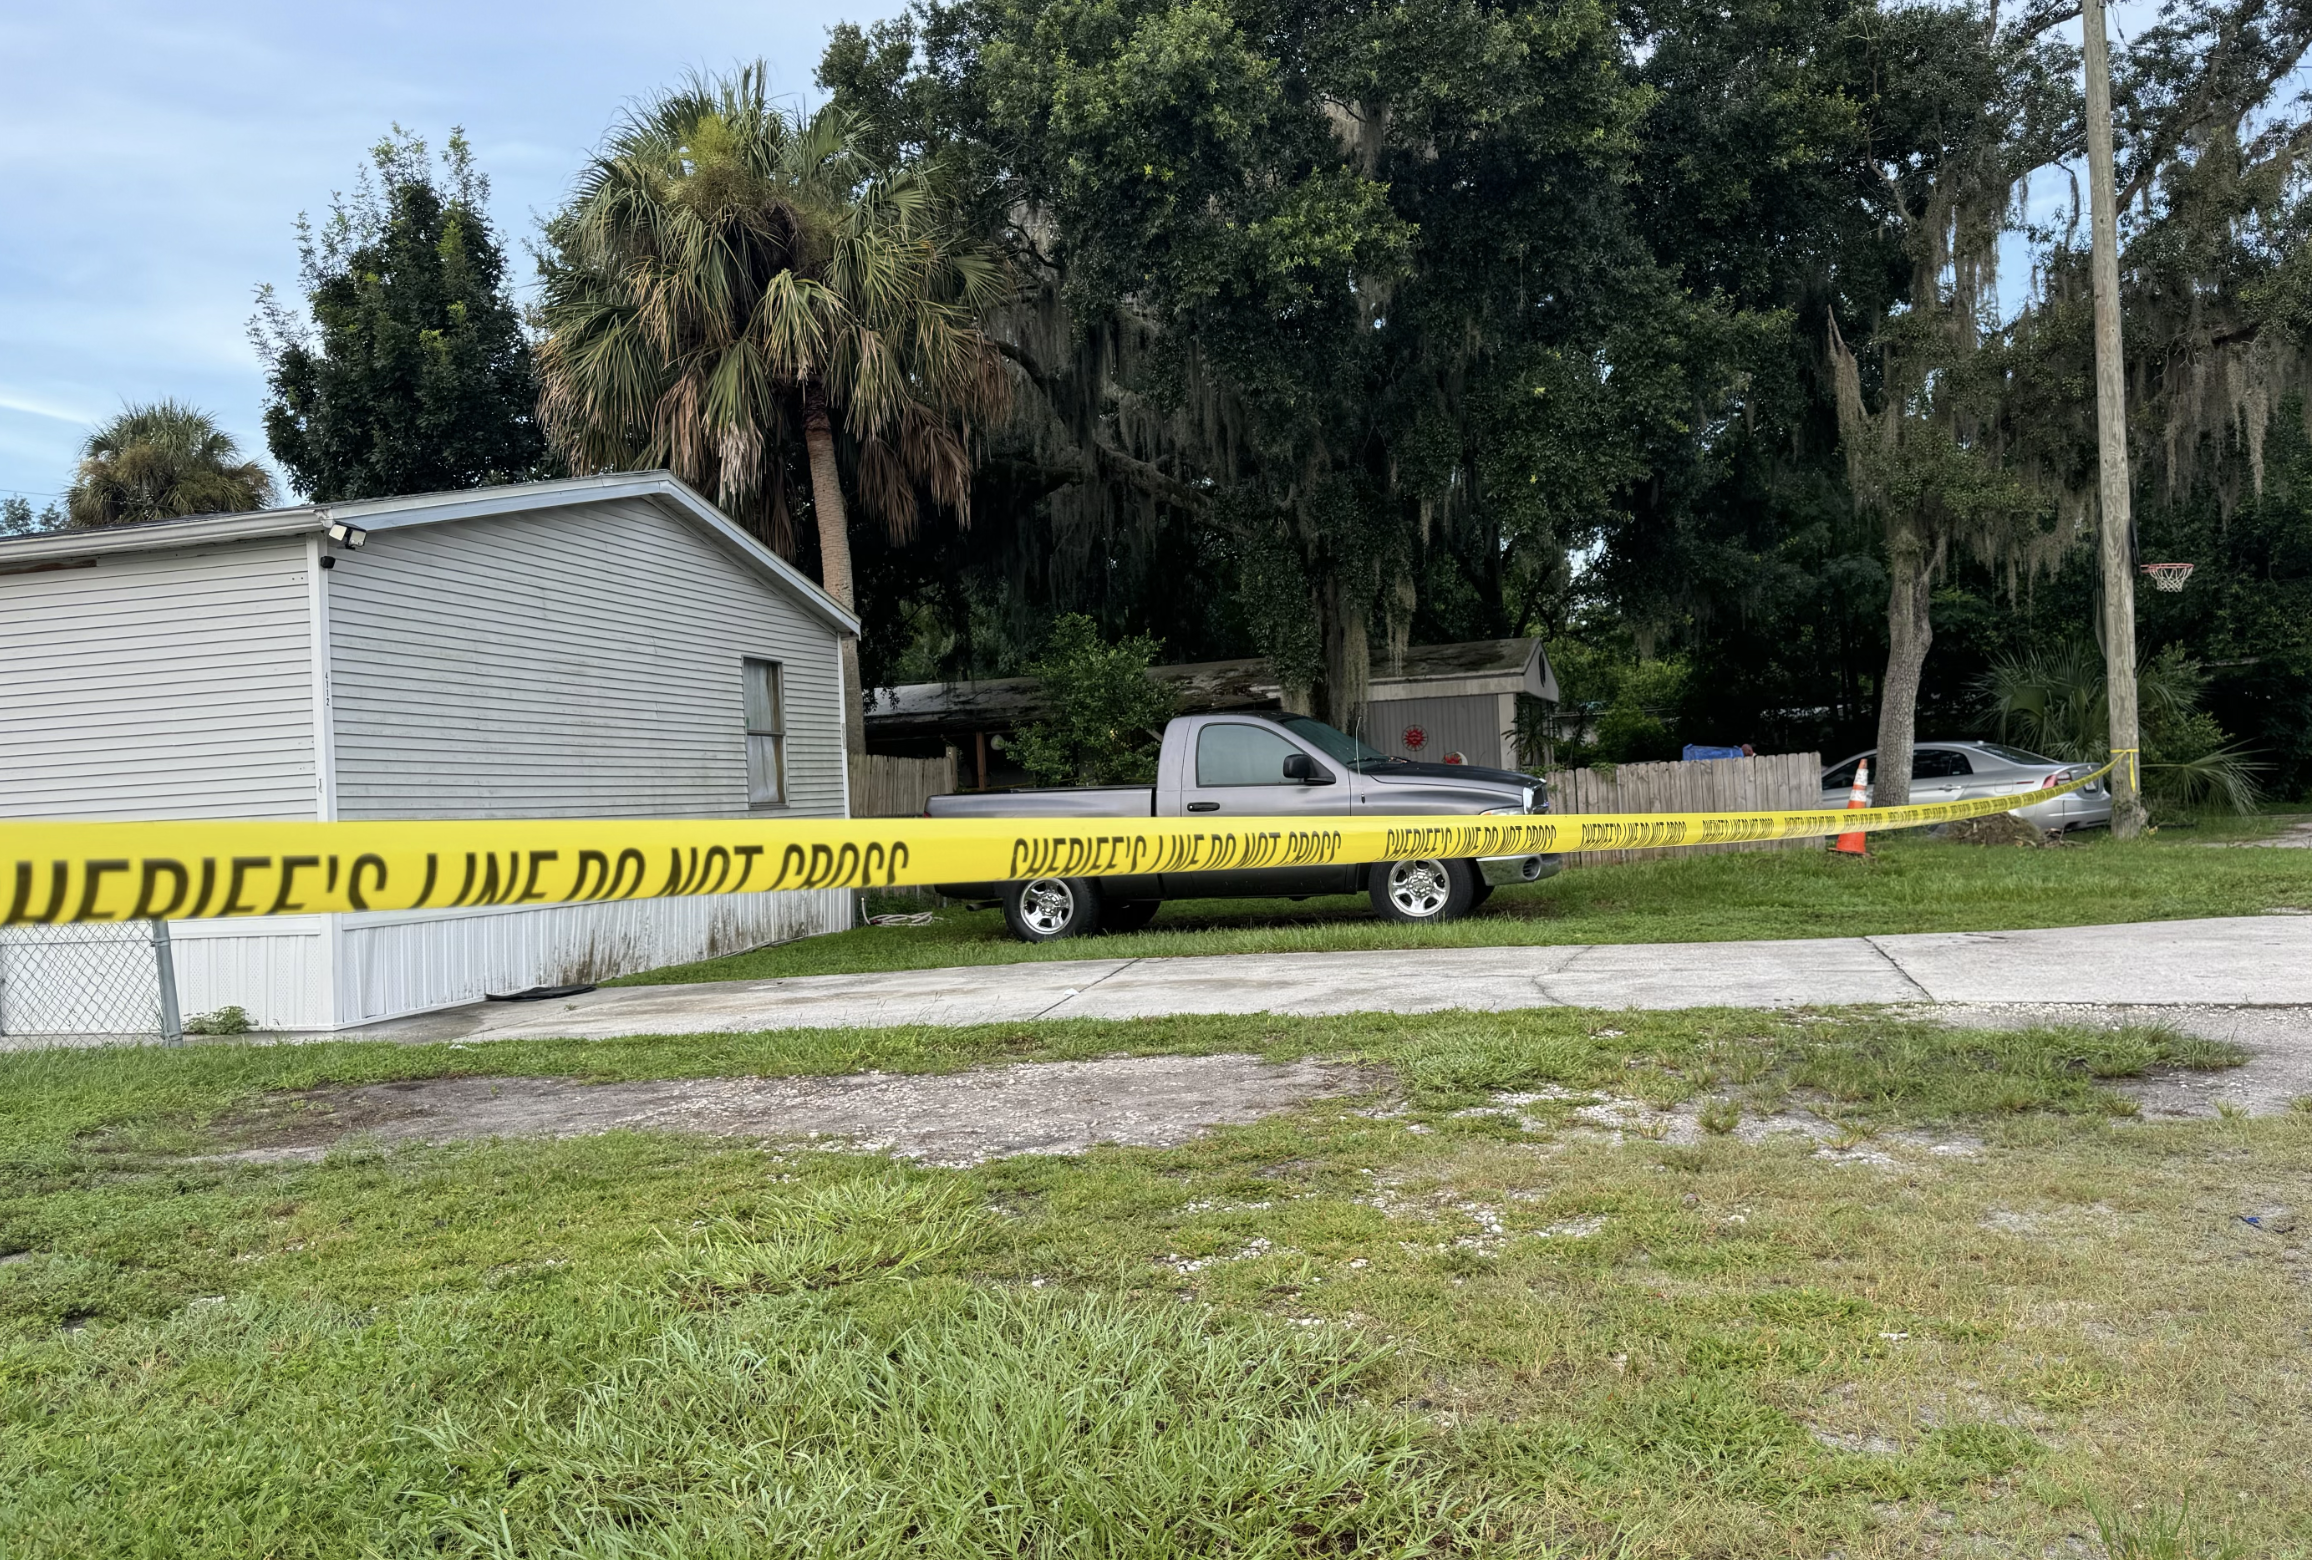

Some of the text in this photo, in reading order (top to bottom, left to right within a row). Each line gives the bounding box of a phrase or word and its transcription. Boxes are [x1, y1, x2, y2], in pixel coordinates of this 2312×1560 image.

[558, 848, 646, 901] DO
[651, 846, 763, 897] NOT
[1200, 833, 1236, 869] DO
[1231, 832, 1281, 868] NOT
